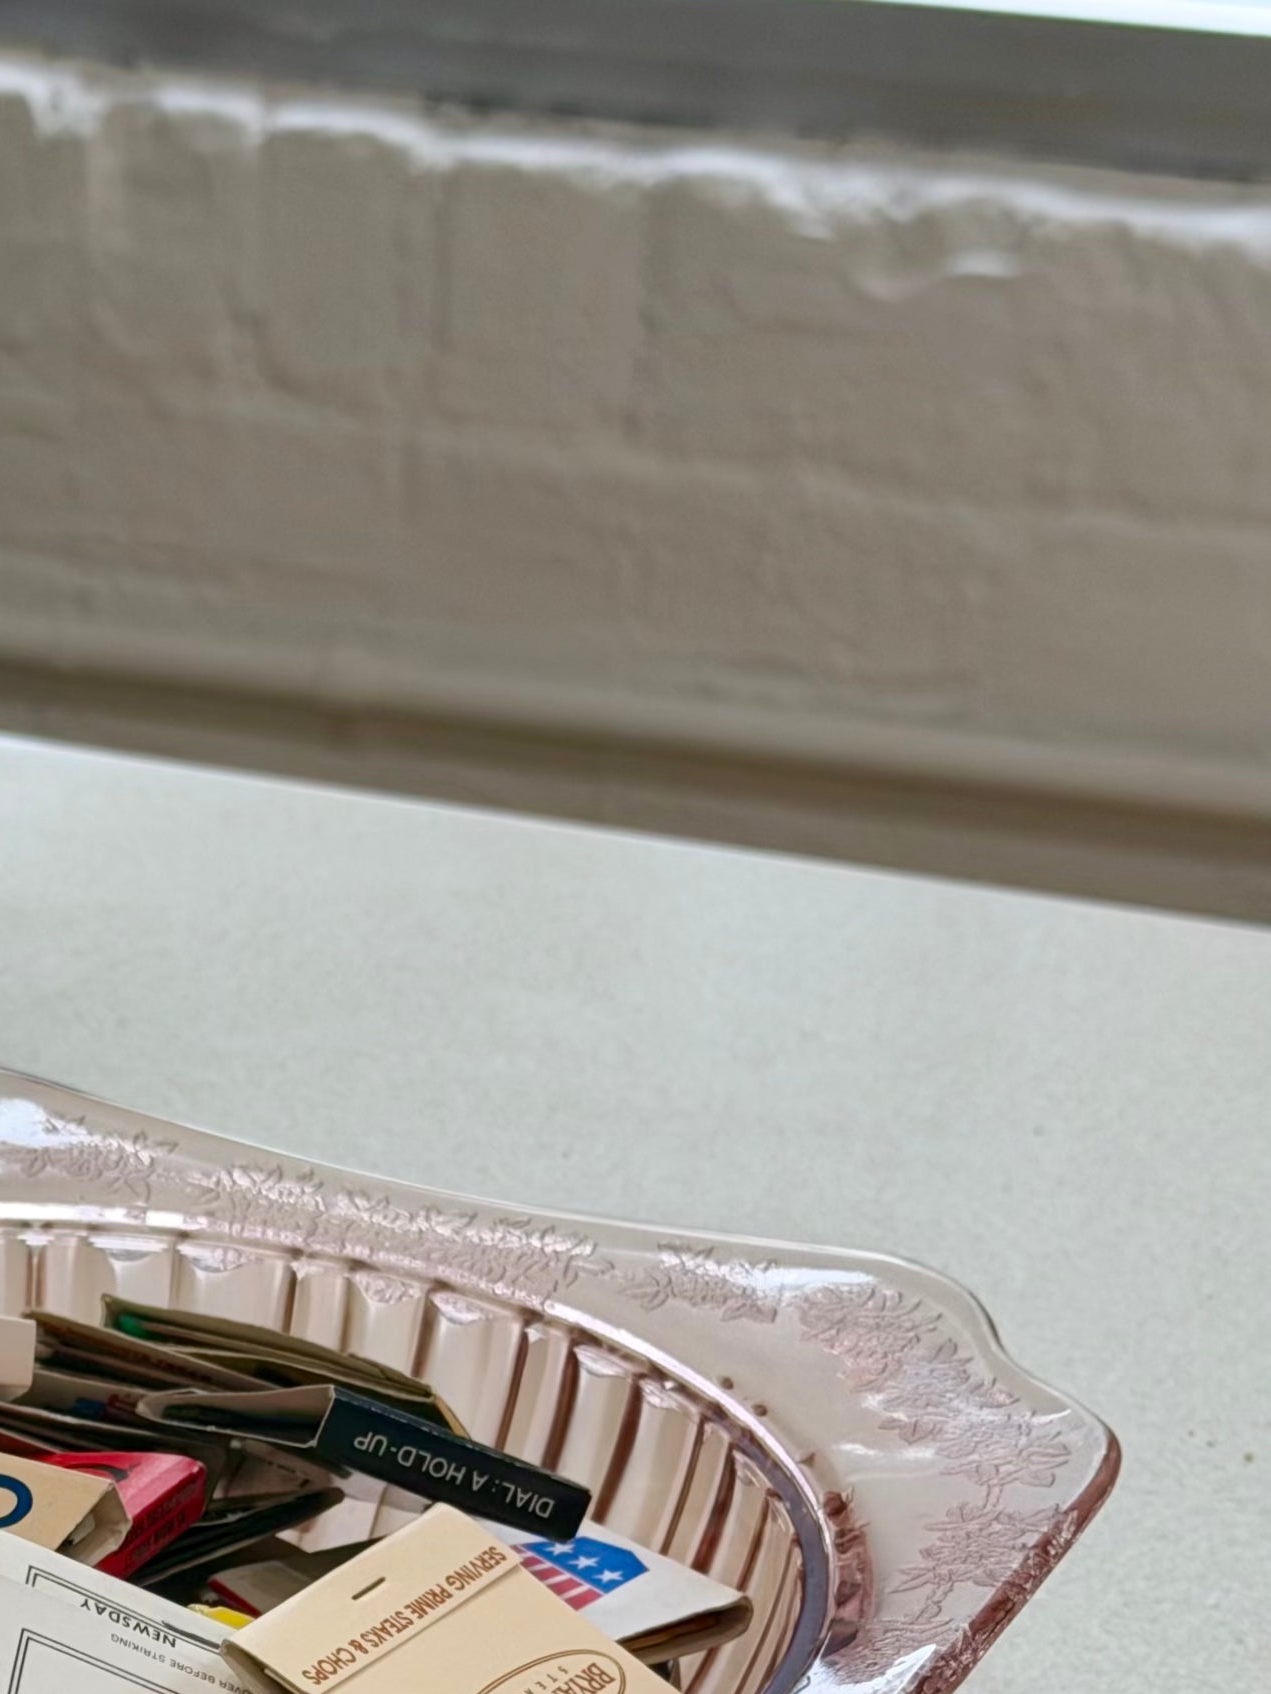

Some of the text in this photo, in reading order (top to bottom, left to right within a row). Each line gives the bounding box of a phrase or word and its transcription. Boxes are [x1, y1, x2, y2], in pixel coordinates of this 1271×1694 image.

[353, 1432, 555, 1518] DIAL: A HOLD-UP
[79, 1598, 177, 1649] NEWSDAY
[301, 1546, 507, 1686] SERVING PRIME STEAKS & CHOPS
[110, 1633, 166, 1664] STRIKING
[169, 1658, 216, 1684] BEFORE
